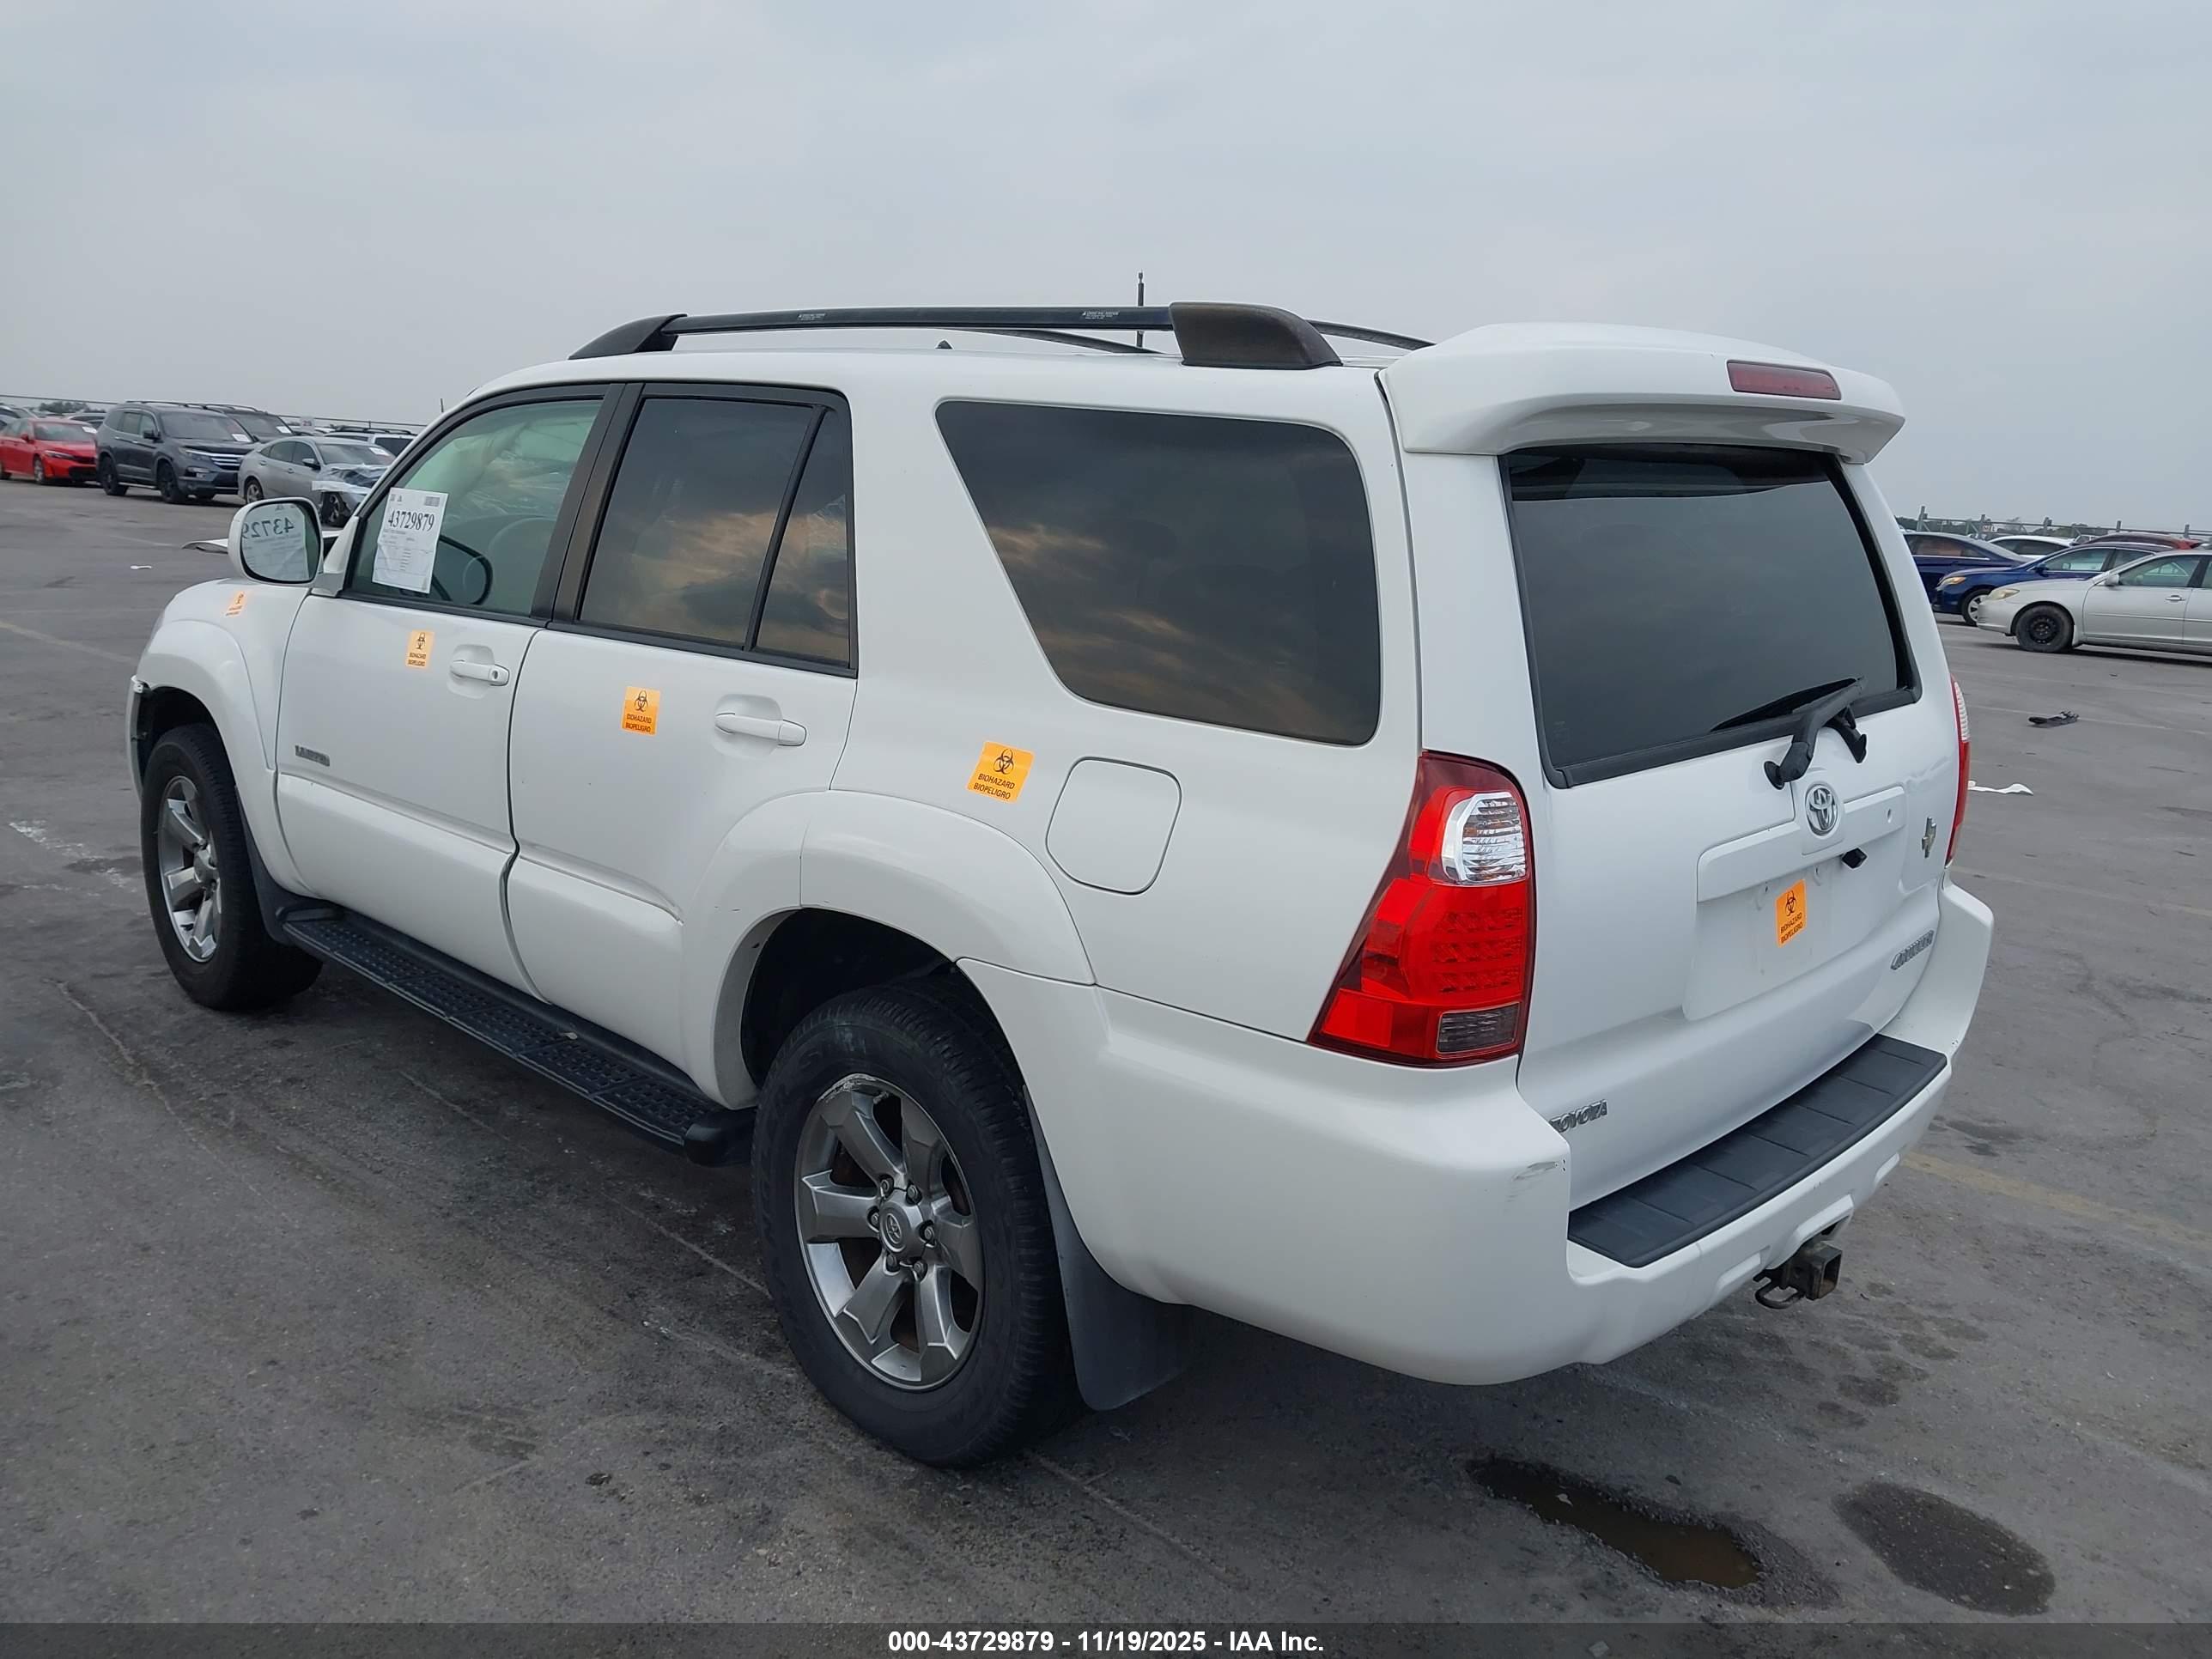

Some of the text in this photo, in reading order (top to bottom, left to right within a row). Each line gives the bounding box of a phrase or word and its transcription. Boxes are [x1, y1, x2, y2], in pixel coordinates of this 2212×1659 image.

[387, 509, 435, 532] 43729879
[977, 773, 1016, 790] BIOHAZARD
[973, 782, 1012, 799] BIOPELIGRO
